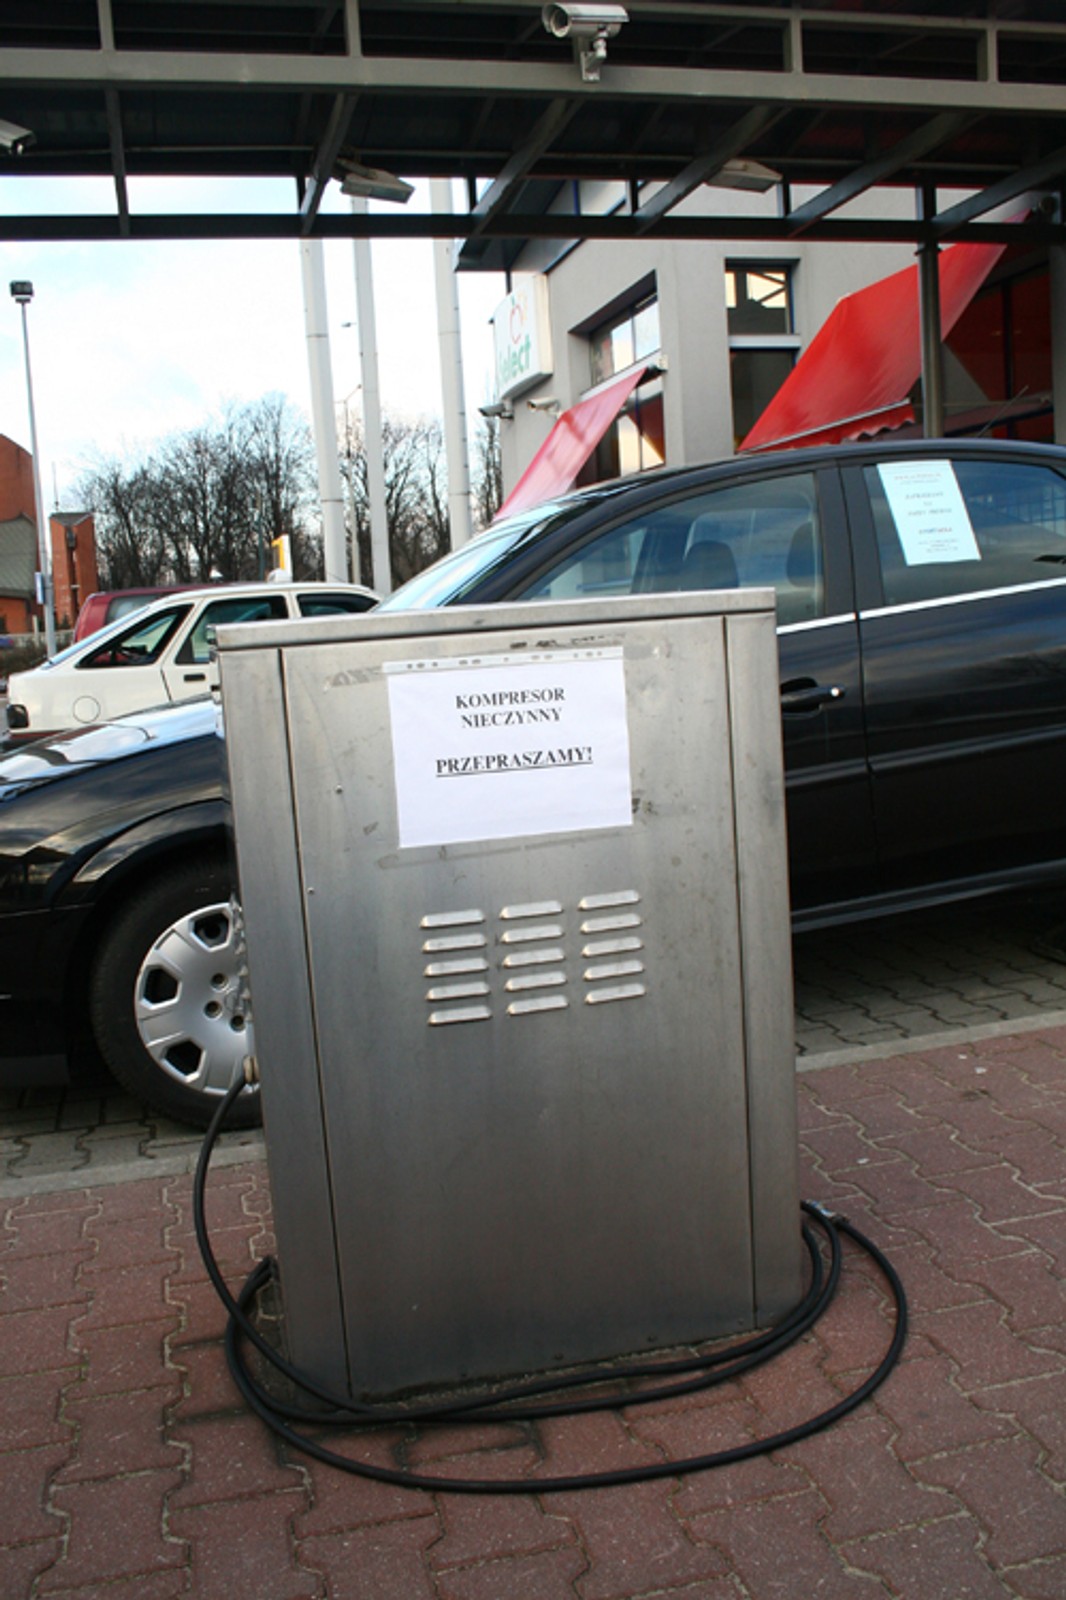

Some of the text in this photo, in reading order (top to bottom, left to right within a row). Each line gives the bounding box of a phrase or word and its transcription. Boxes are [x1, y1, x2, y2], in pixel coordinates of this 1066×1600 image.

[455, 687, 566, 710] KOMPRESOR
[461, 707, 563, 729] NIECZYNNY
[436, 746, 593, 776] PRZEPRASZAMY!
